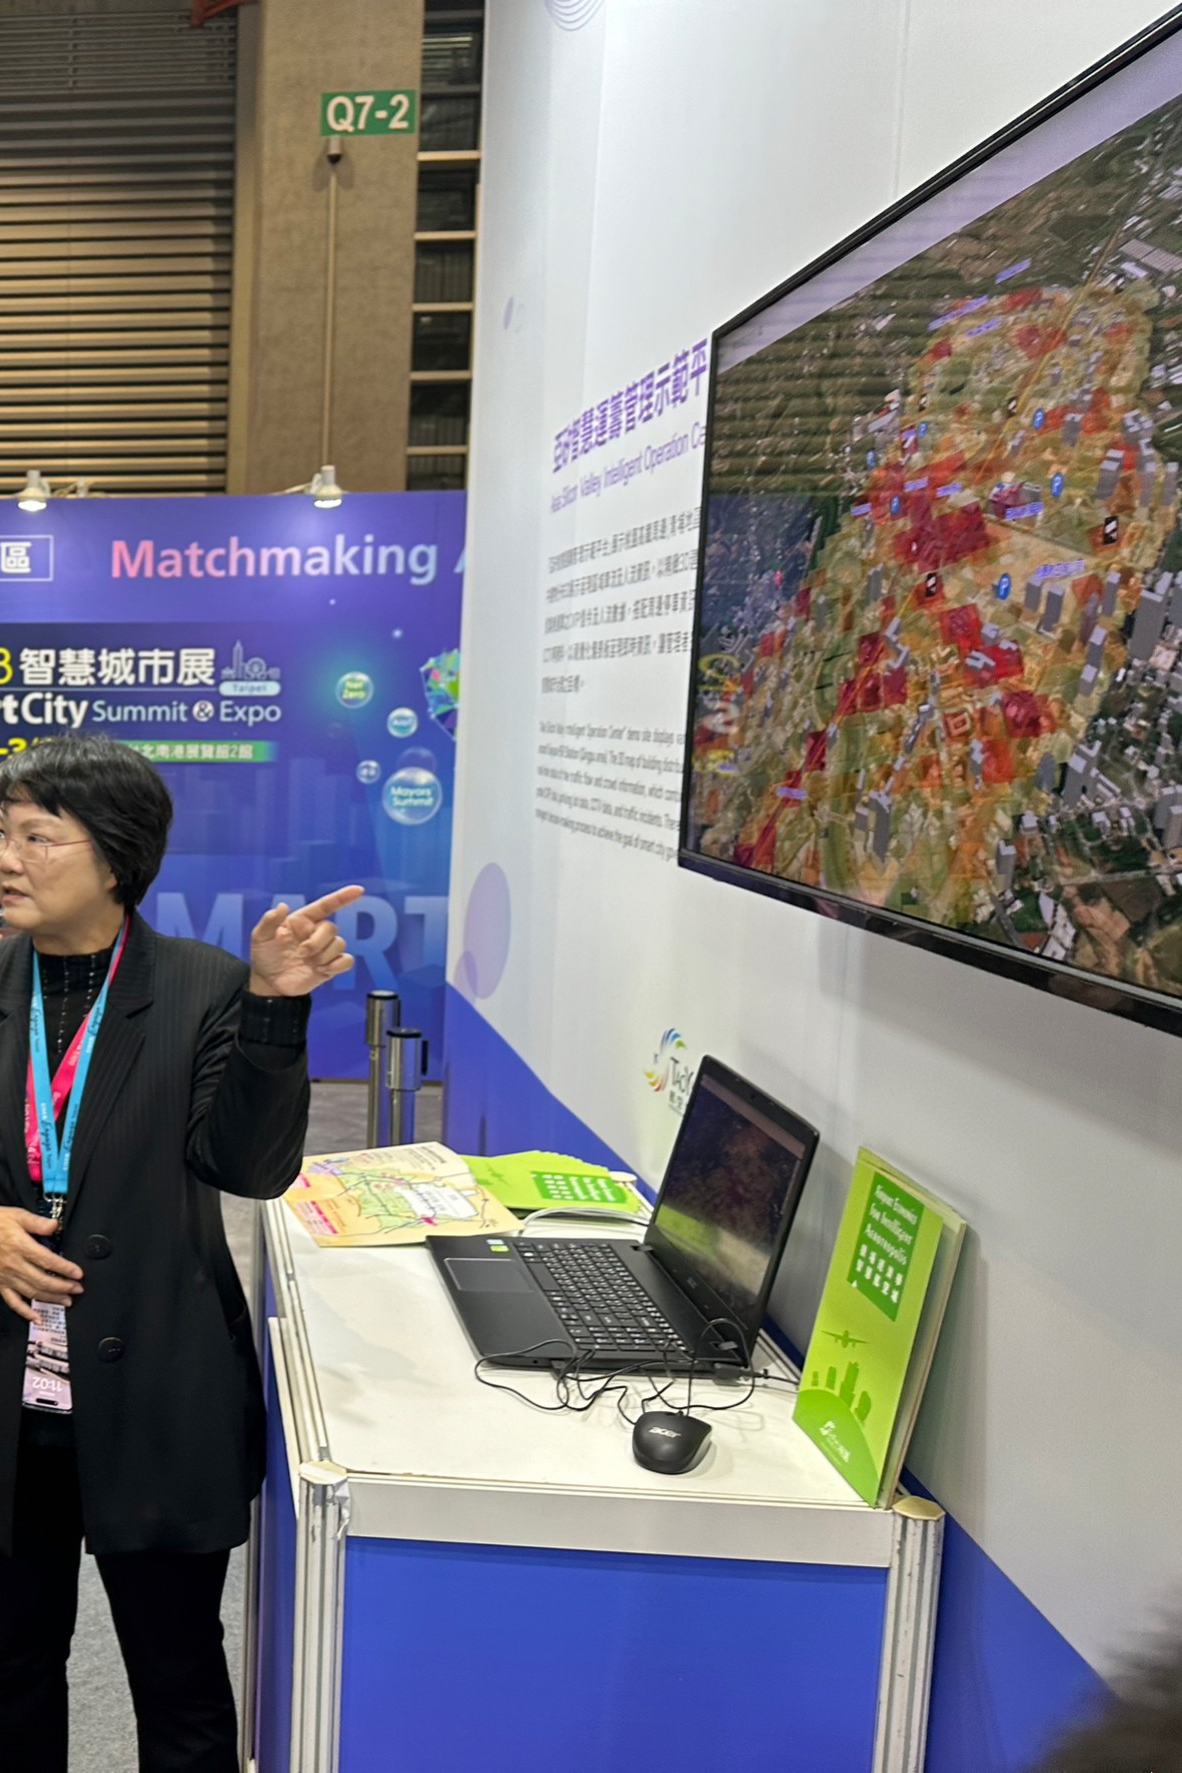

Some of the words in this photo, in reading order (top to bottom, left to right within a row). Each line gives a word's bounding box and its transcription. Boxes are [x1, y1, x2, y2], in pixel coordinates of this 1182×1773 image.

[327, 94, 410, 132] Q7-2
[644, 433, 689, 473] Operation
[111, 534, 437, 586] Matchmaking
[19, 648, 215, 686] 智慧城市展
[232, 684, 267, 694] Taipei
[92, 700, 188, 722] Summit
[193, 701, 214, 722] &
[220, 701, 281, 727] Expo
[392, 796, 434, 807] Summit
[32, 1377, 63, 1392] 11:02
[649, 1426, 681, 1438] acer
